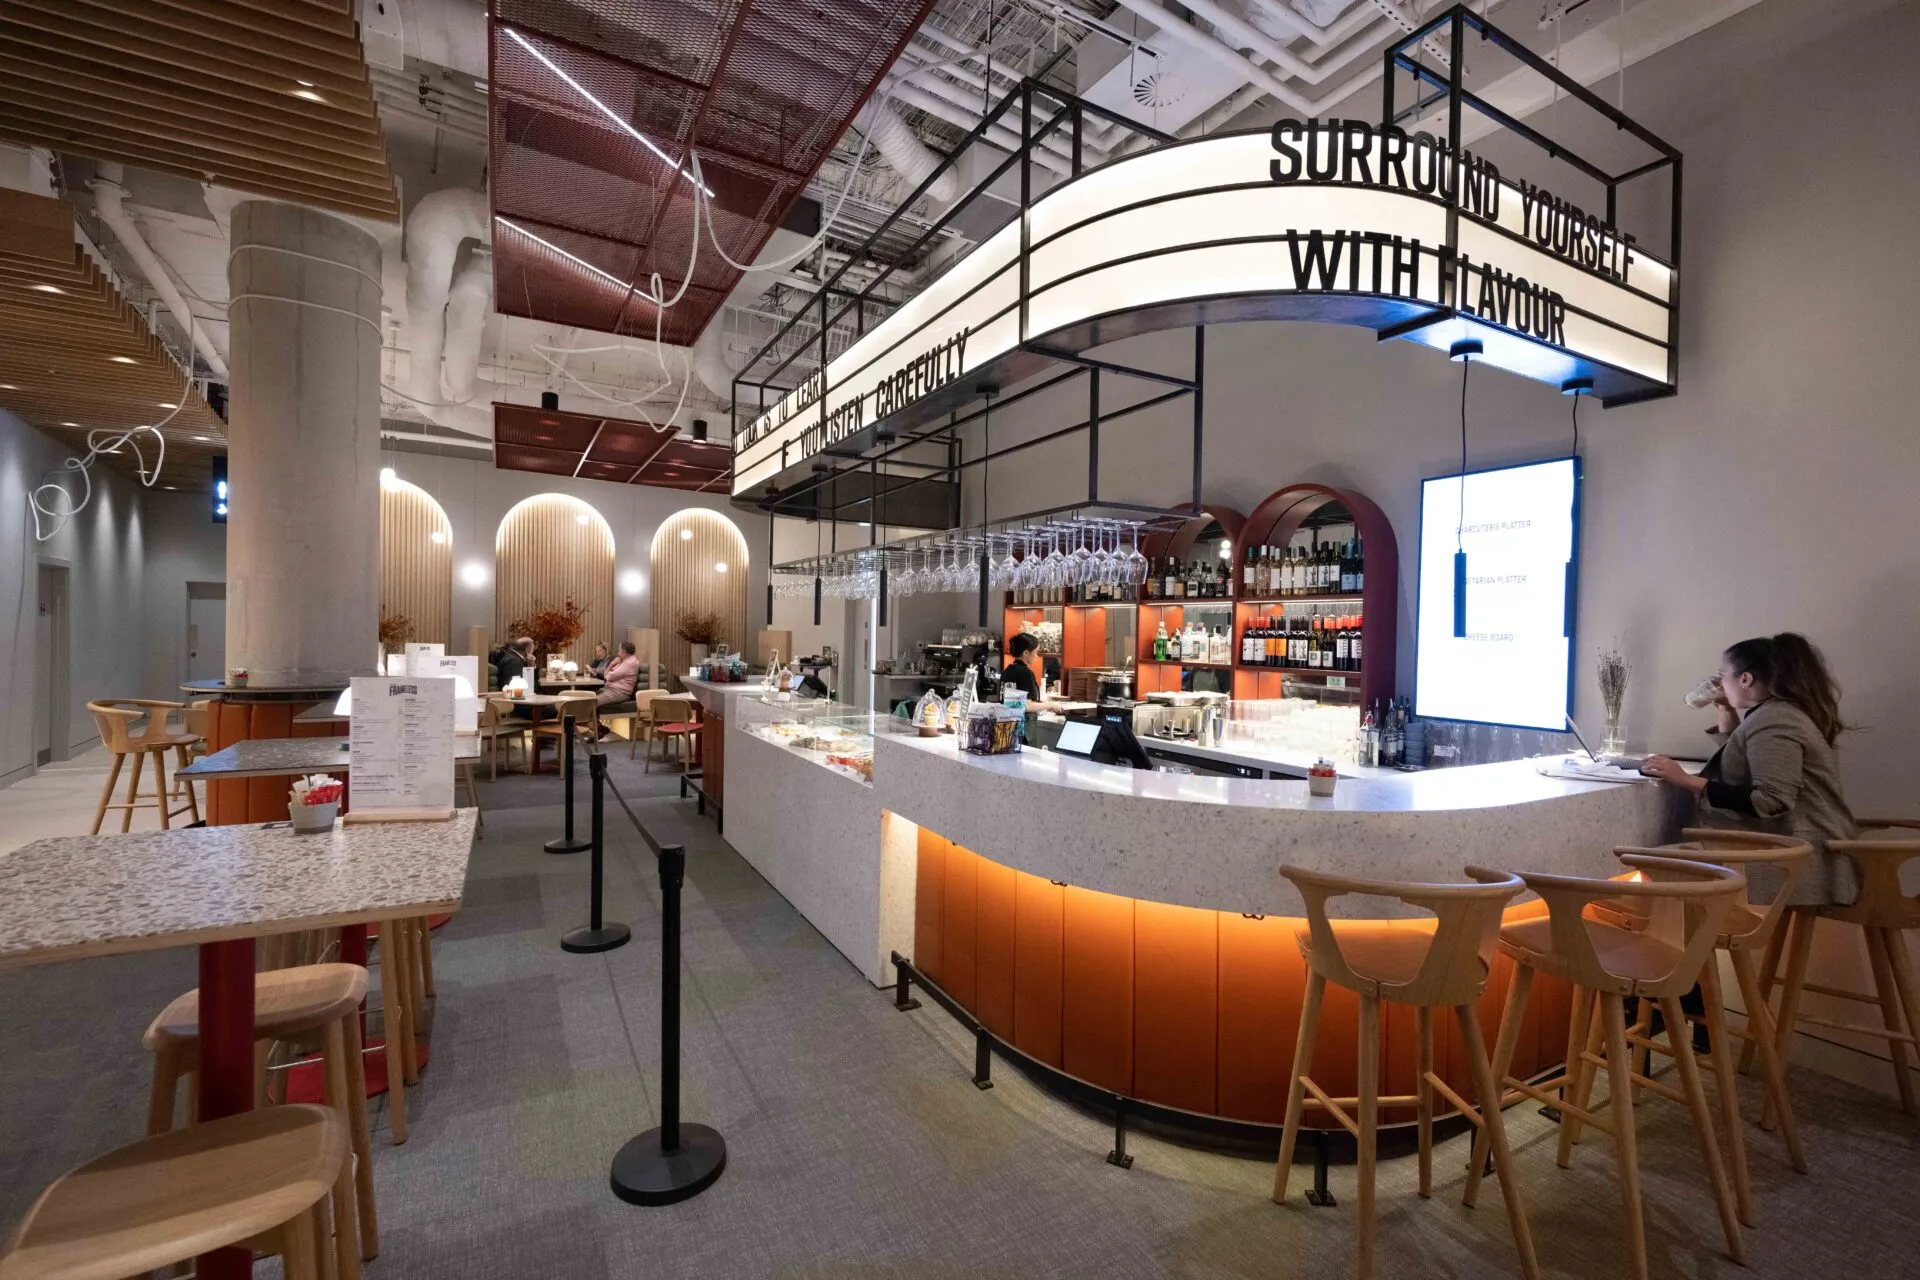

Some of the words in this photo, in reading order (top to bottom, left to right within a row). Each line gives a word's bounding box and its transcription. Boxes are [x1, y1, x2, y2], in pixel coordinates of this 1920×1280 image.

[1270, 117, 1500, 223] SURROUND
[1519, 178, 1636, 284] YOURSELF
[1286, 229, 1420, 299] WITH
[1438, 244, 1566, 347] FLAVOUR
[800, 420, 820, 461] YOU
[825, 392, 864, 446] LISTEN
[875, 327, 970, 421] CAREFULLY
[1502, 520, 1531, 531] PLATTER
[1497, 575, 1527, 584] PLATTER
[1490, 633, 1514, 642] BOARD
